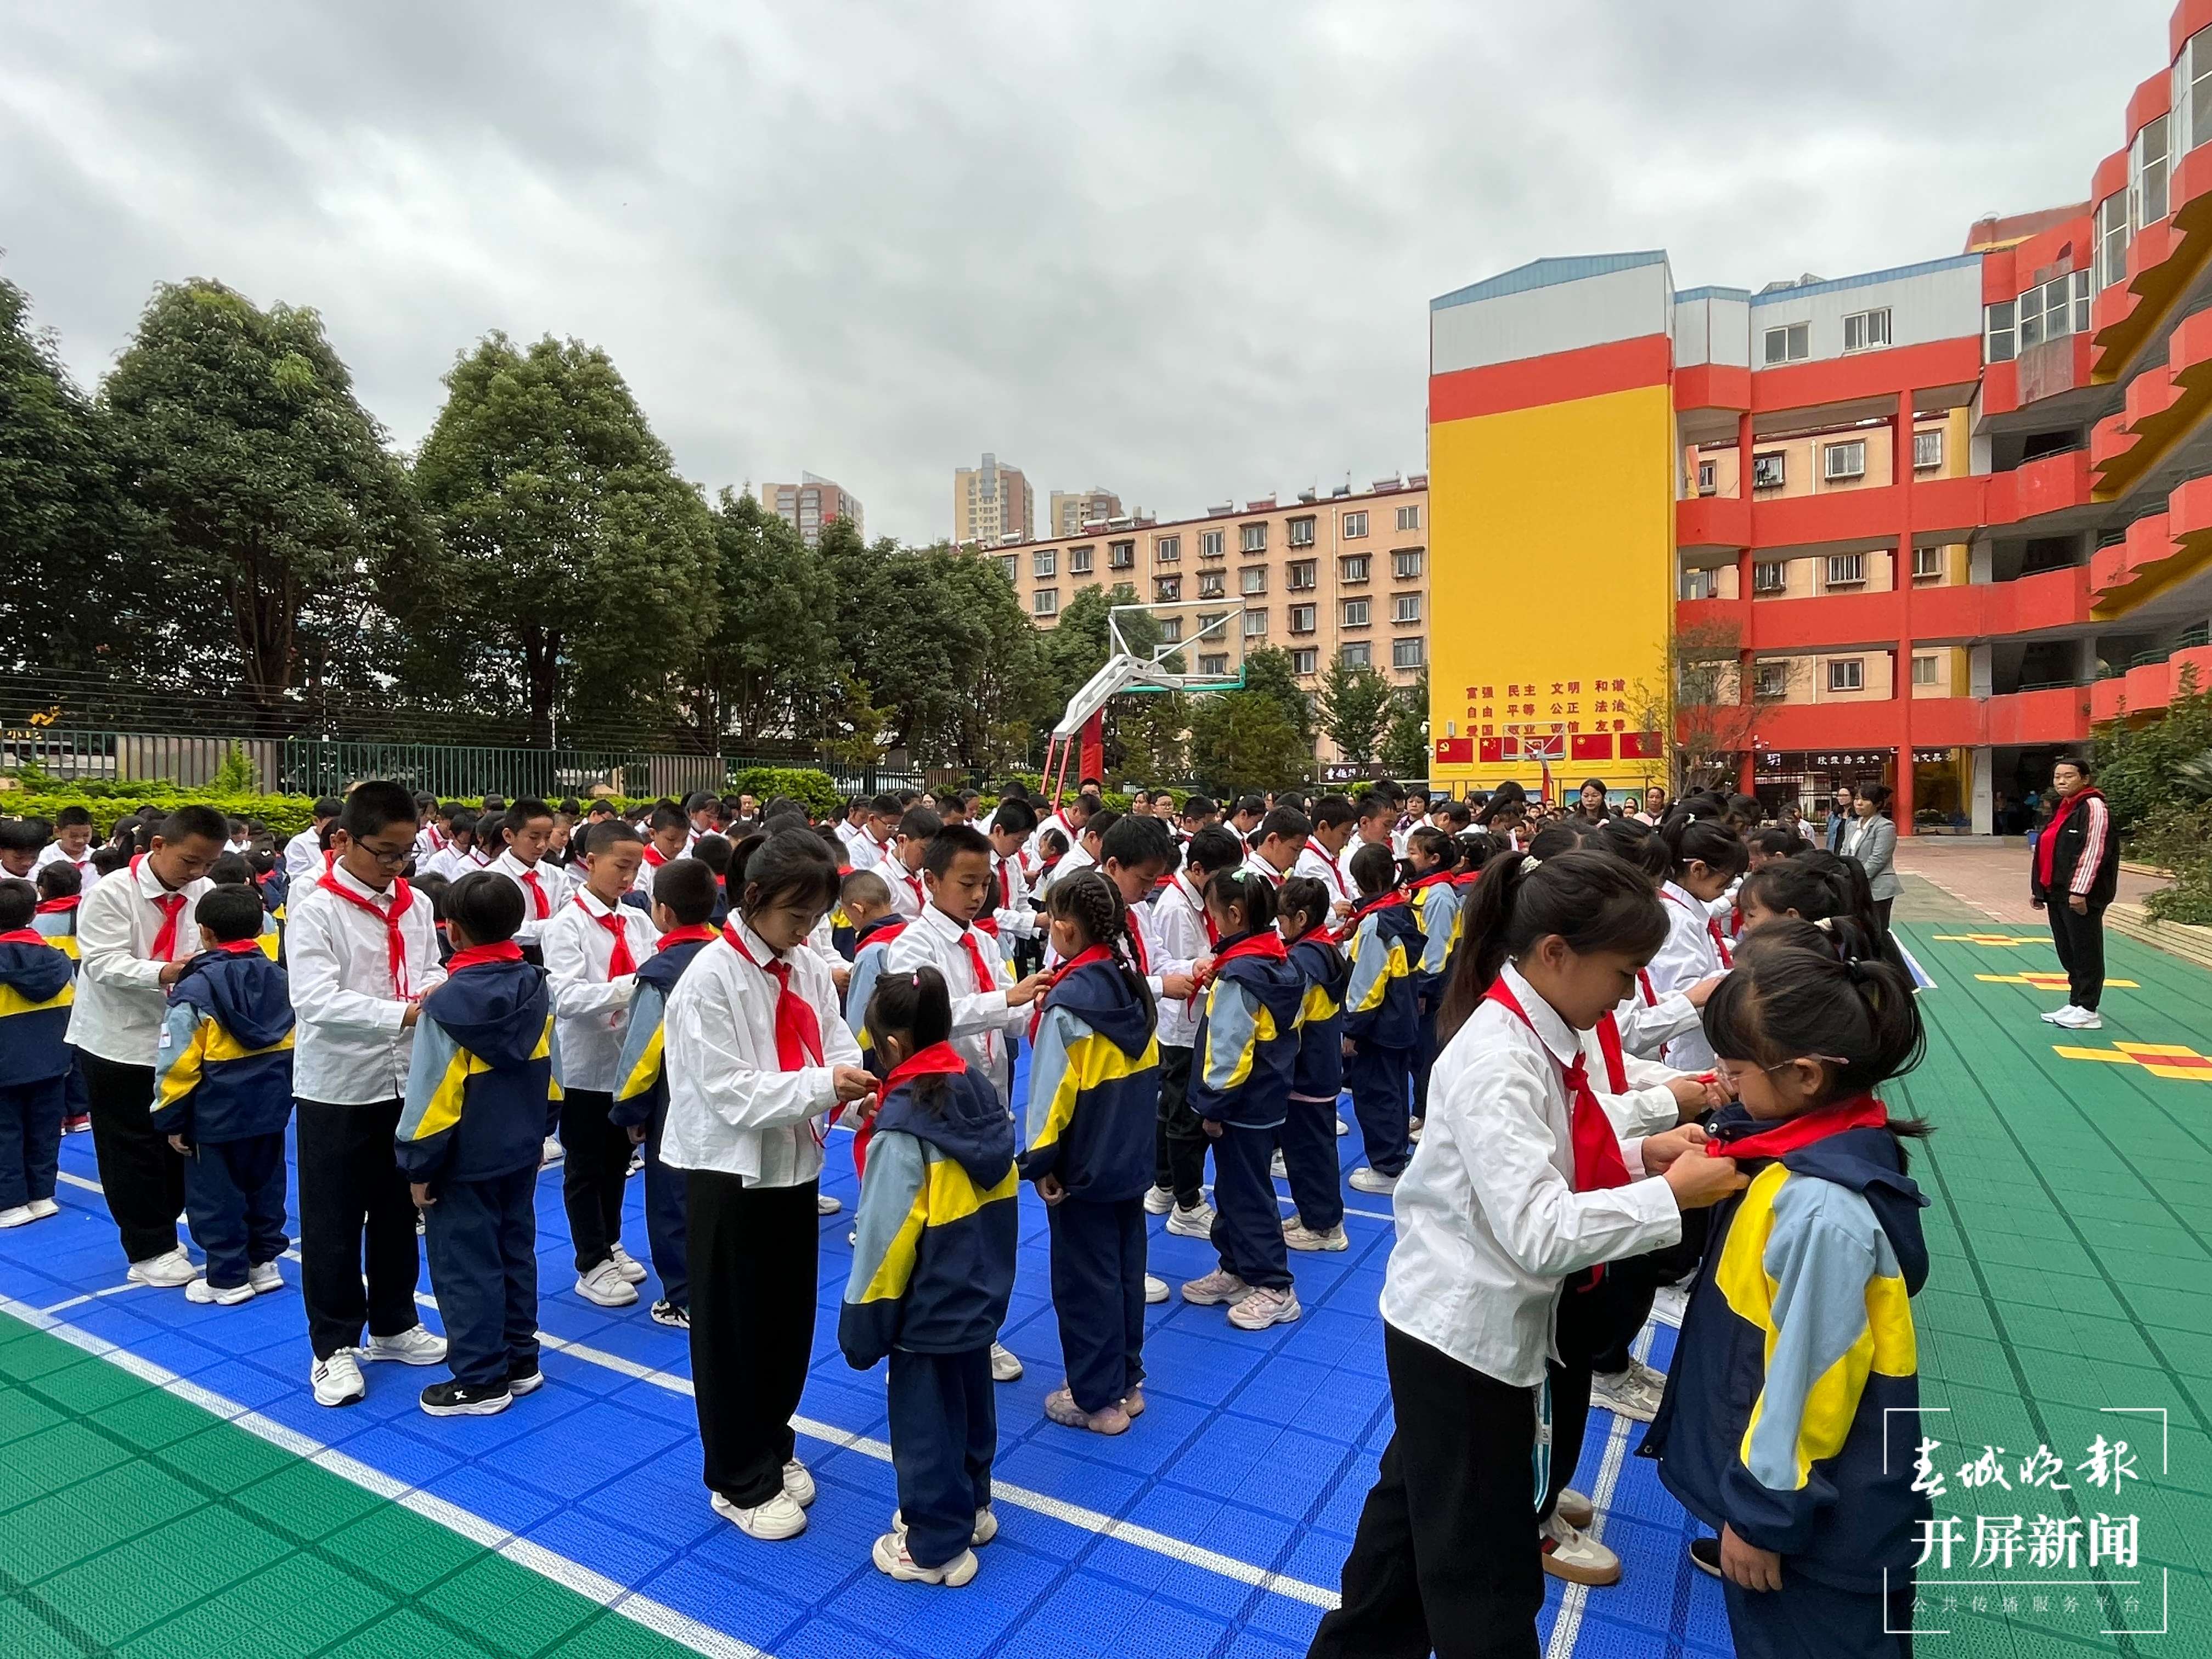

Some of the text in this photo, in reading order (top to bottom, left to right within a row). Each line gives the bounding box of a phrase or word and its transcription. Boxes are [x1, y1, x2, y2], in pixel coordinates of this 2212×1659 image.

[1466, 679, 1625, 700] 富强 民主 文明 和谐
[1467, 699, 1626, 719] 自由 平等 公正 法治
[1466, 724, 1493, 737] 爱国
[1595, 719, 1626, 732] 友善
